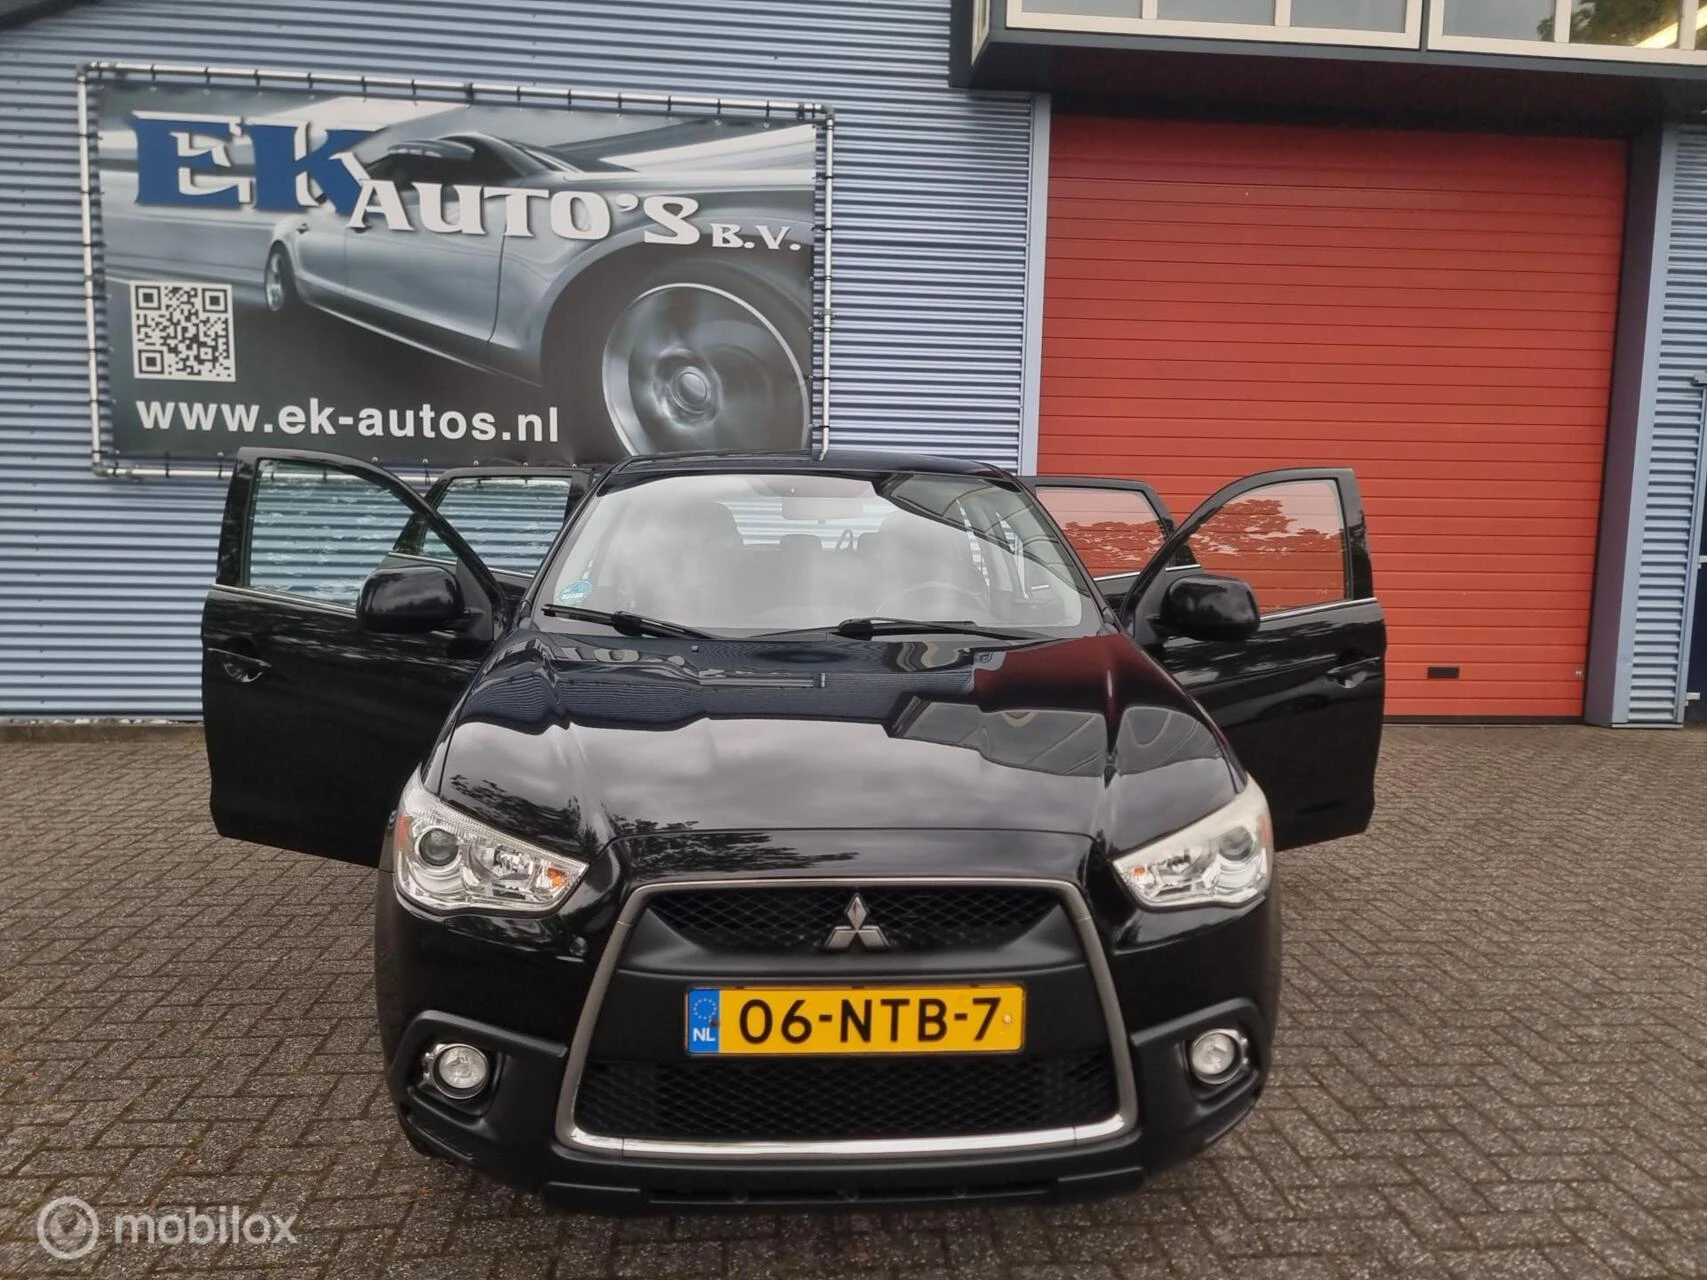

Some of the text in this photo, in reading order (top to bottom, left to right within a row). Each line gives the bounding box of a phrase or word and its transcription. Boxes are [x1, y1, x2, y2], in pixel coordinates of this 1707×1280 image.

[132, 111, 388, 215] EK
[711, 223, 801, 250] B.V.
[135, 398, 559, 443] www.ek-autos.nl
[692, 1027, 716, 1043] NL
[738, 997, 1002, 1045] 06-NTB-7
